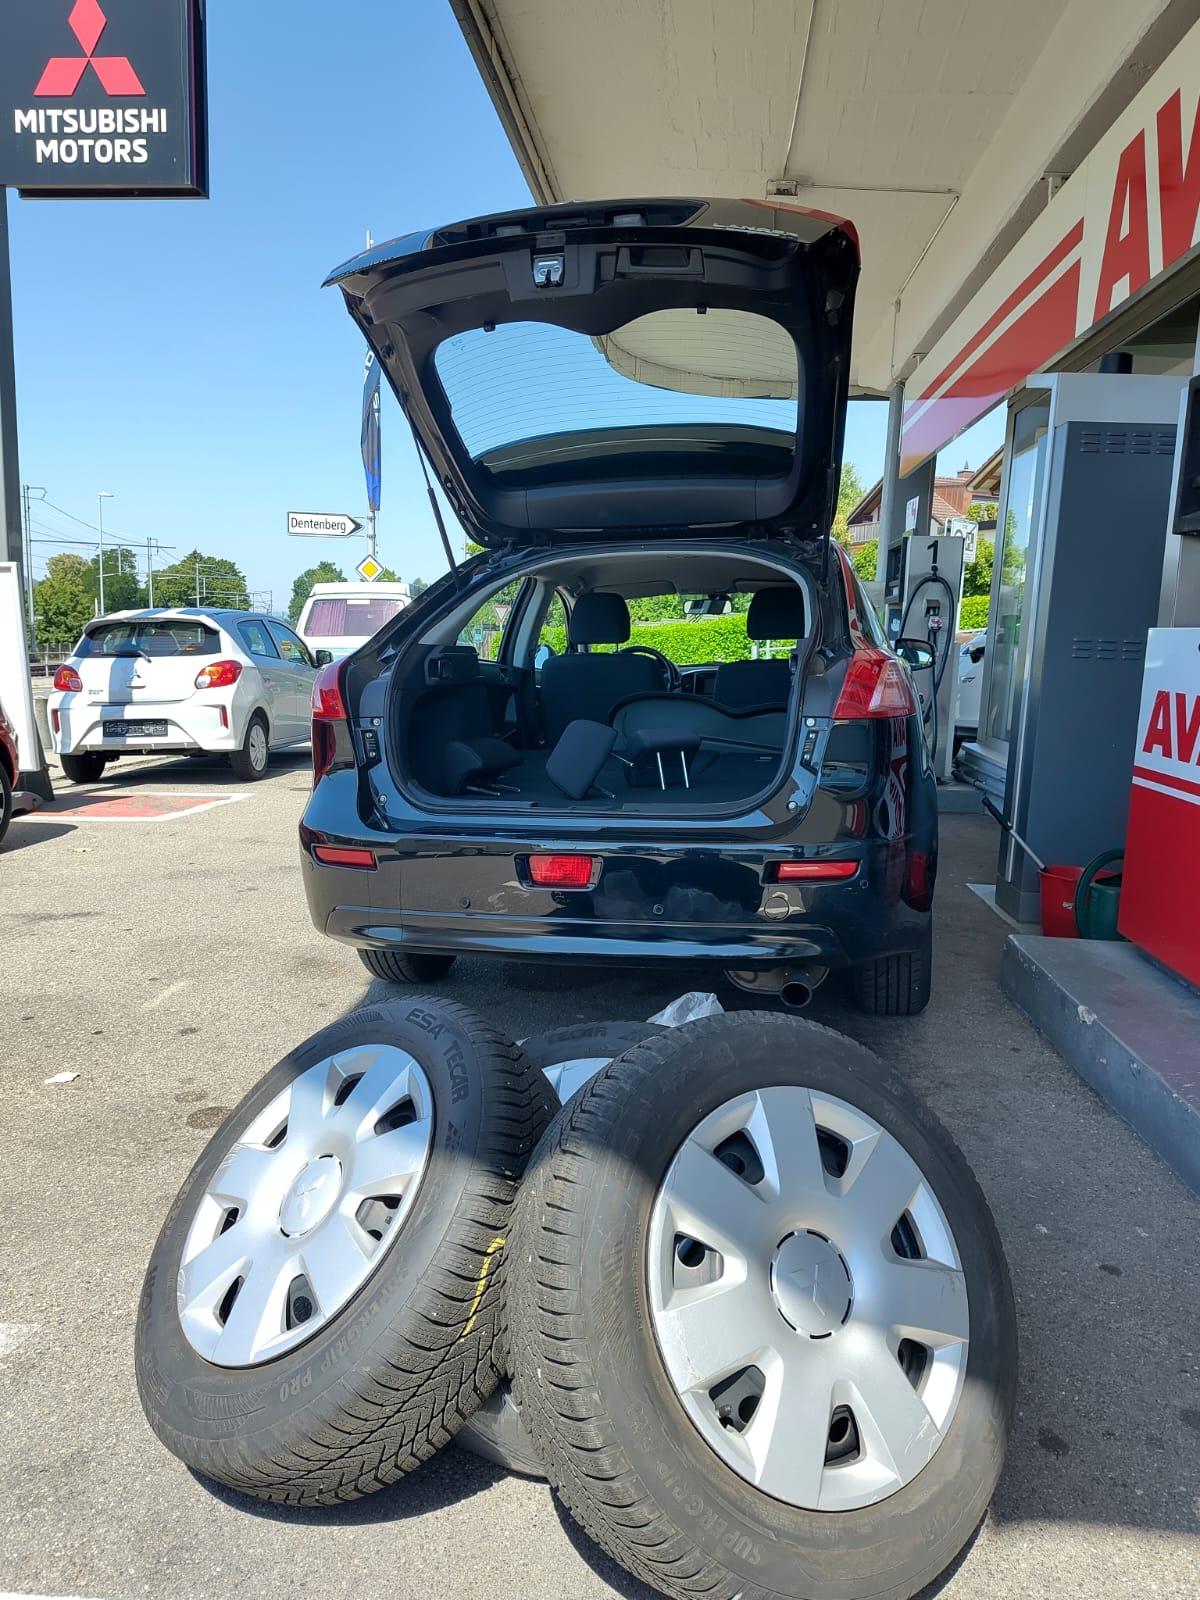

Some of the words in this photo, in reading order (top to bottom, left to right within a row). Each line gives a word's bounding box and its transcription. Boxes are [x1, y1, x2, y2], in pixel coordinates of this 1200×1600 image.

[14, 108, 168, 134] MITSUBISHI
[35, 138, 149, 164] MOTORS
[291, 517, 346, 533] Dentenberg
[927, 540, 939, 564] 1
[1142, 689, 1200, 766] AV
[405, 1007, 444, 1041] ESA
[443, 1039, 470, 1105] TECAR
[279, 1366, 313, 1402] PRO
[655, 1460, 761, 1566] SUPERGRIP
